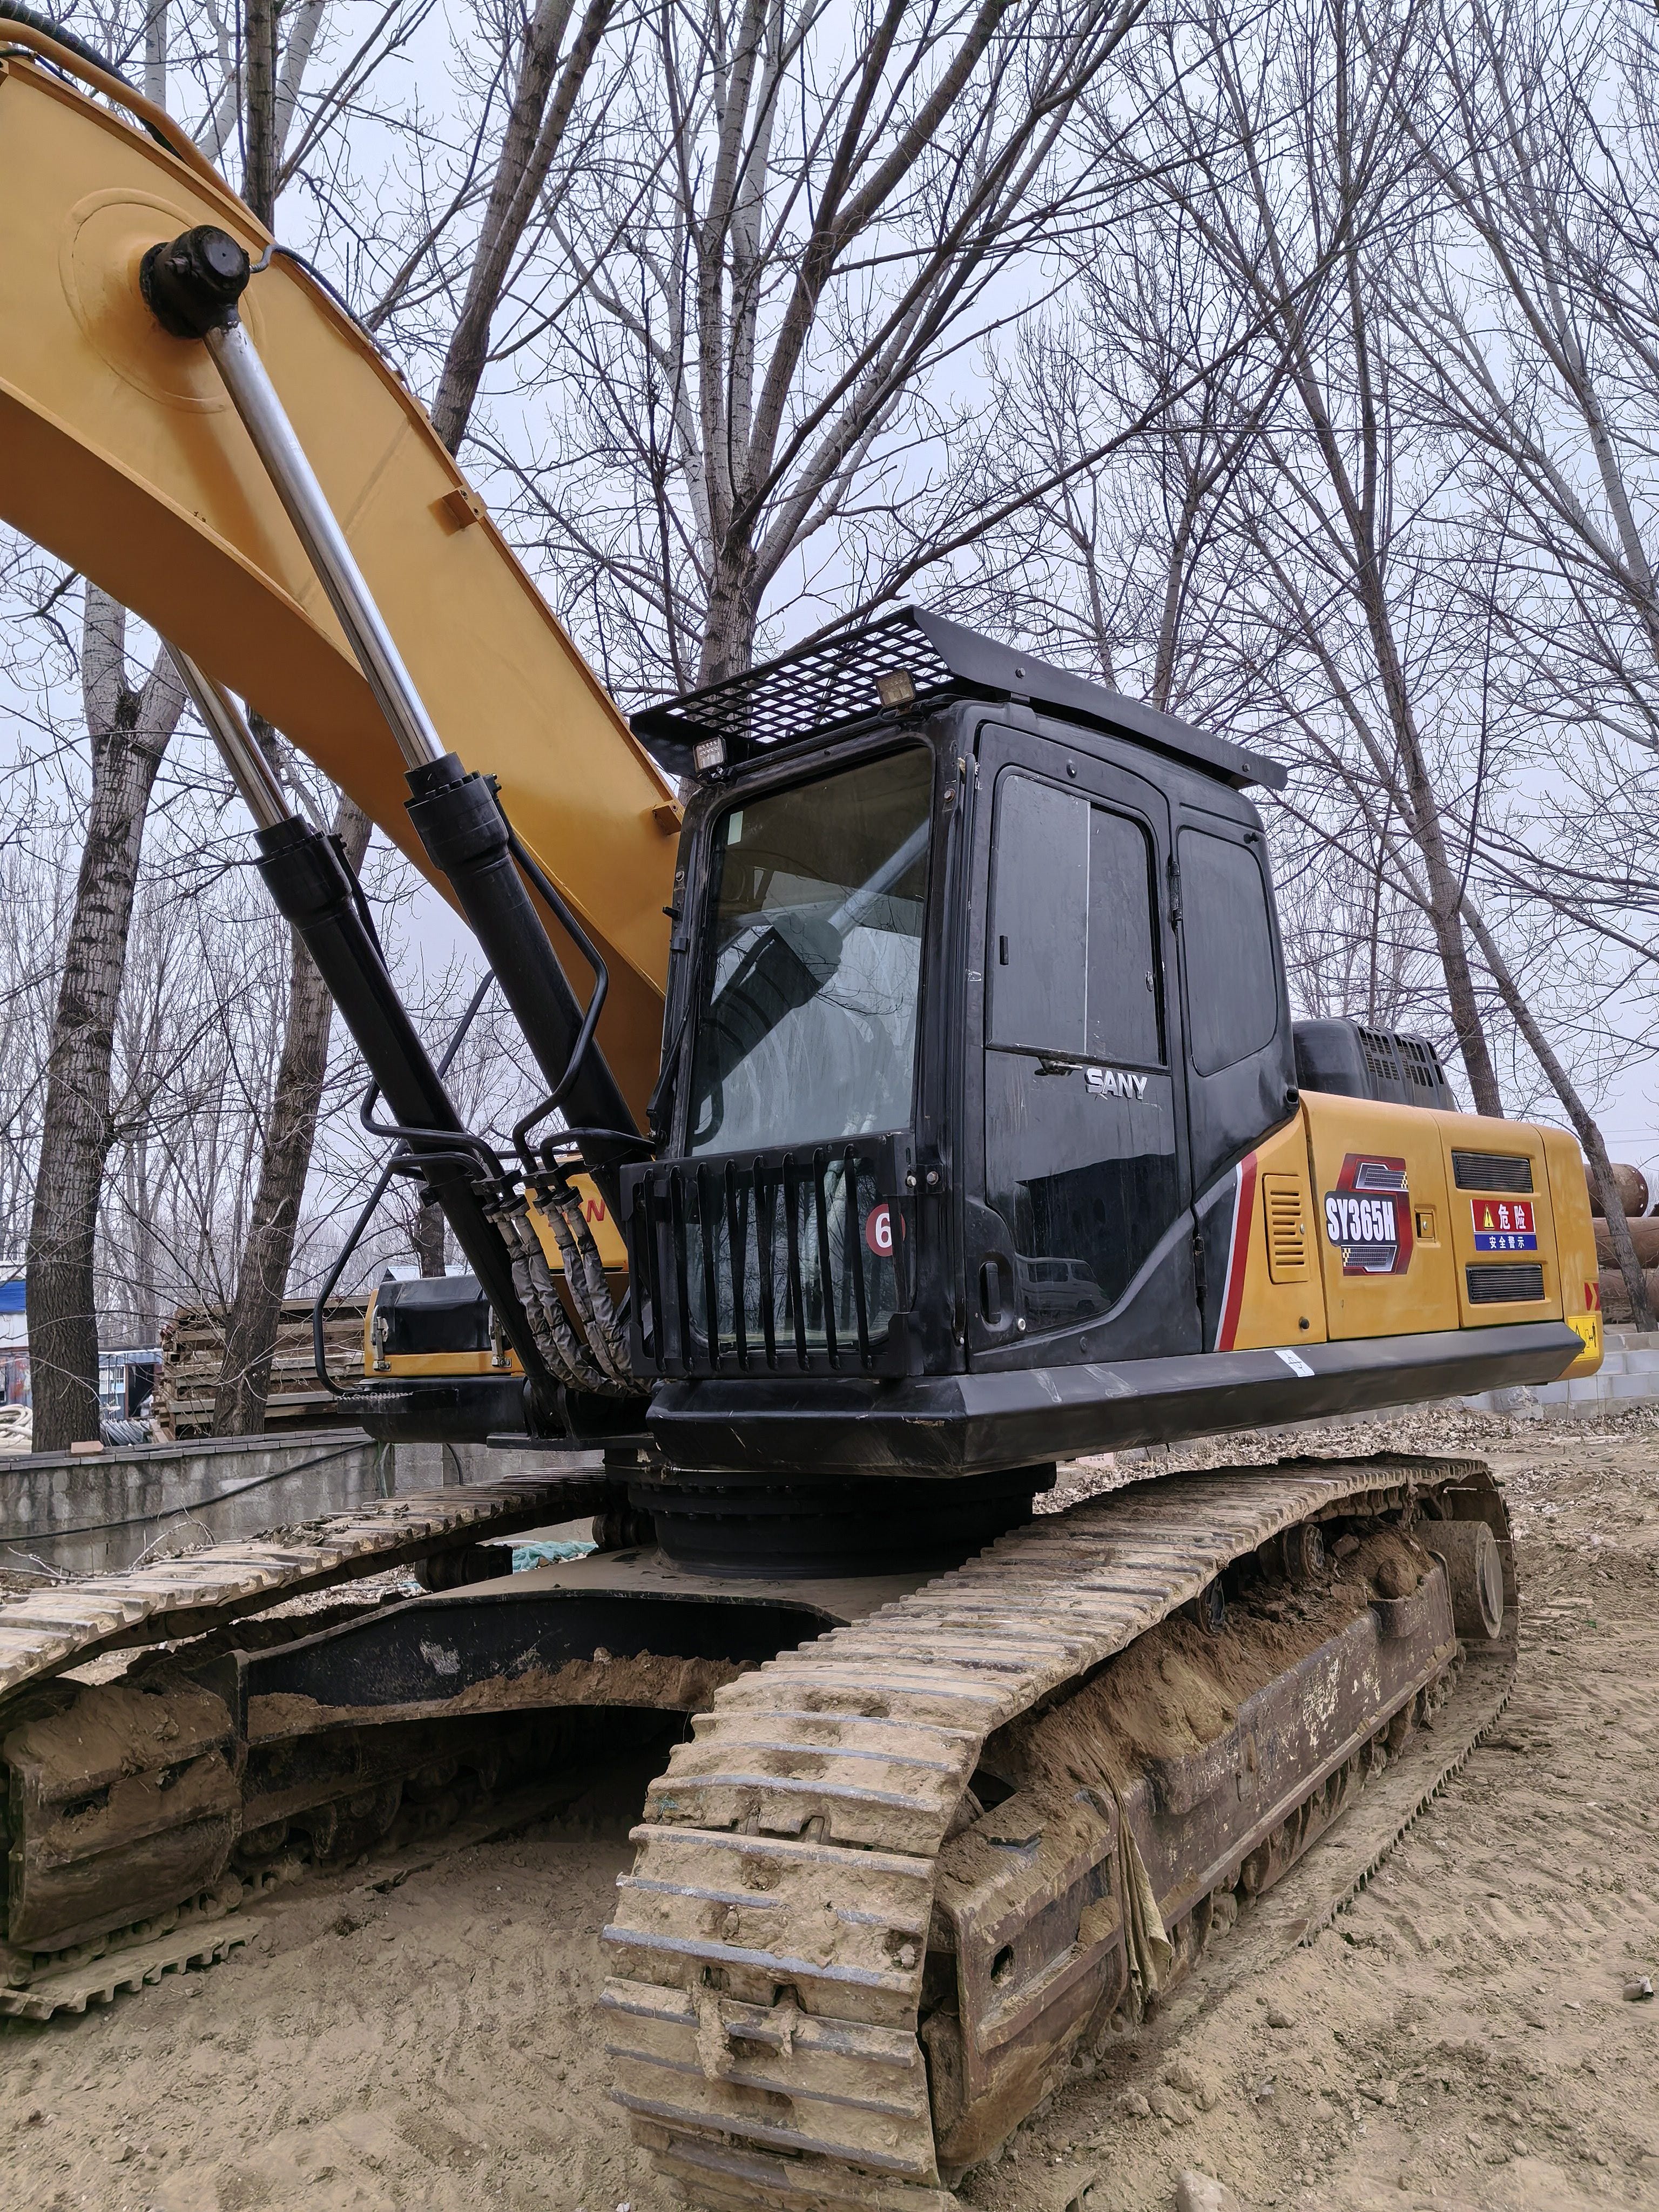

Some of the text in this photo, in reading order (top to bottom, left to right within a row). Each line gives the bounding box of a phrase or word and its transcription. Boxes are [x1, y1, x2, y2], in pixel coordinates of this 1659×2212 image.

[1084, 1068, 1148, 1100] SANY
[1326, 1197, 1396, 1241] SY365H
[1498, 1204, 1526, 1230] 危险
[1489, 1236, 1525, 1249] 安全警示
